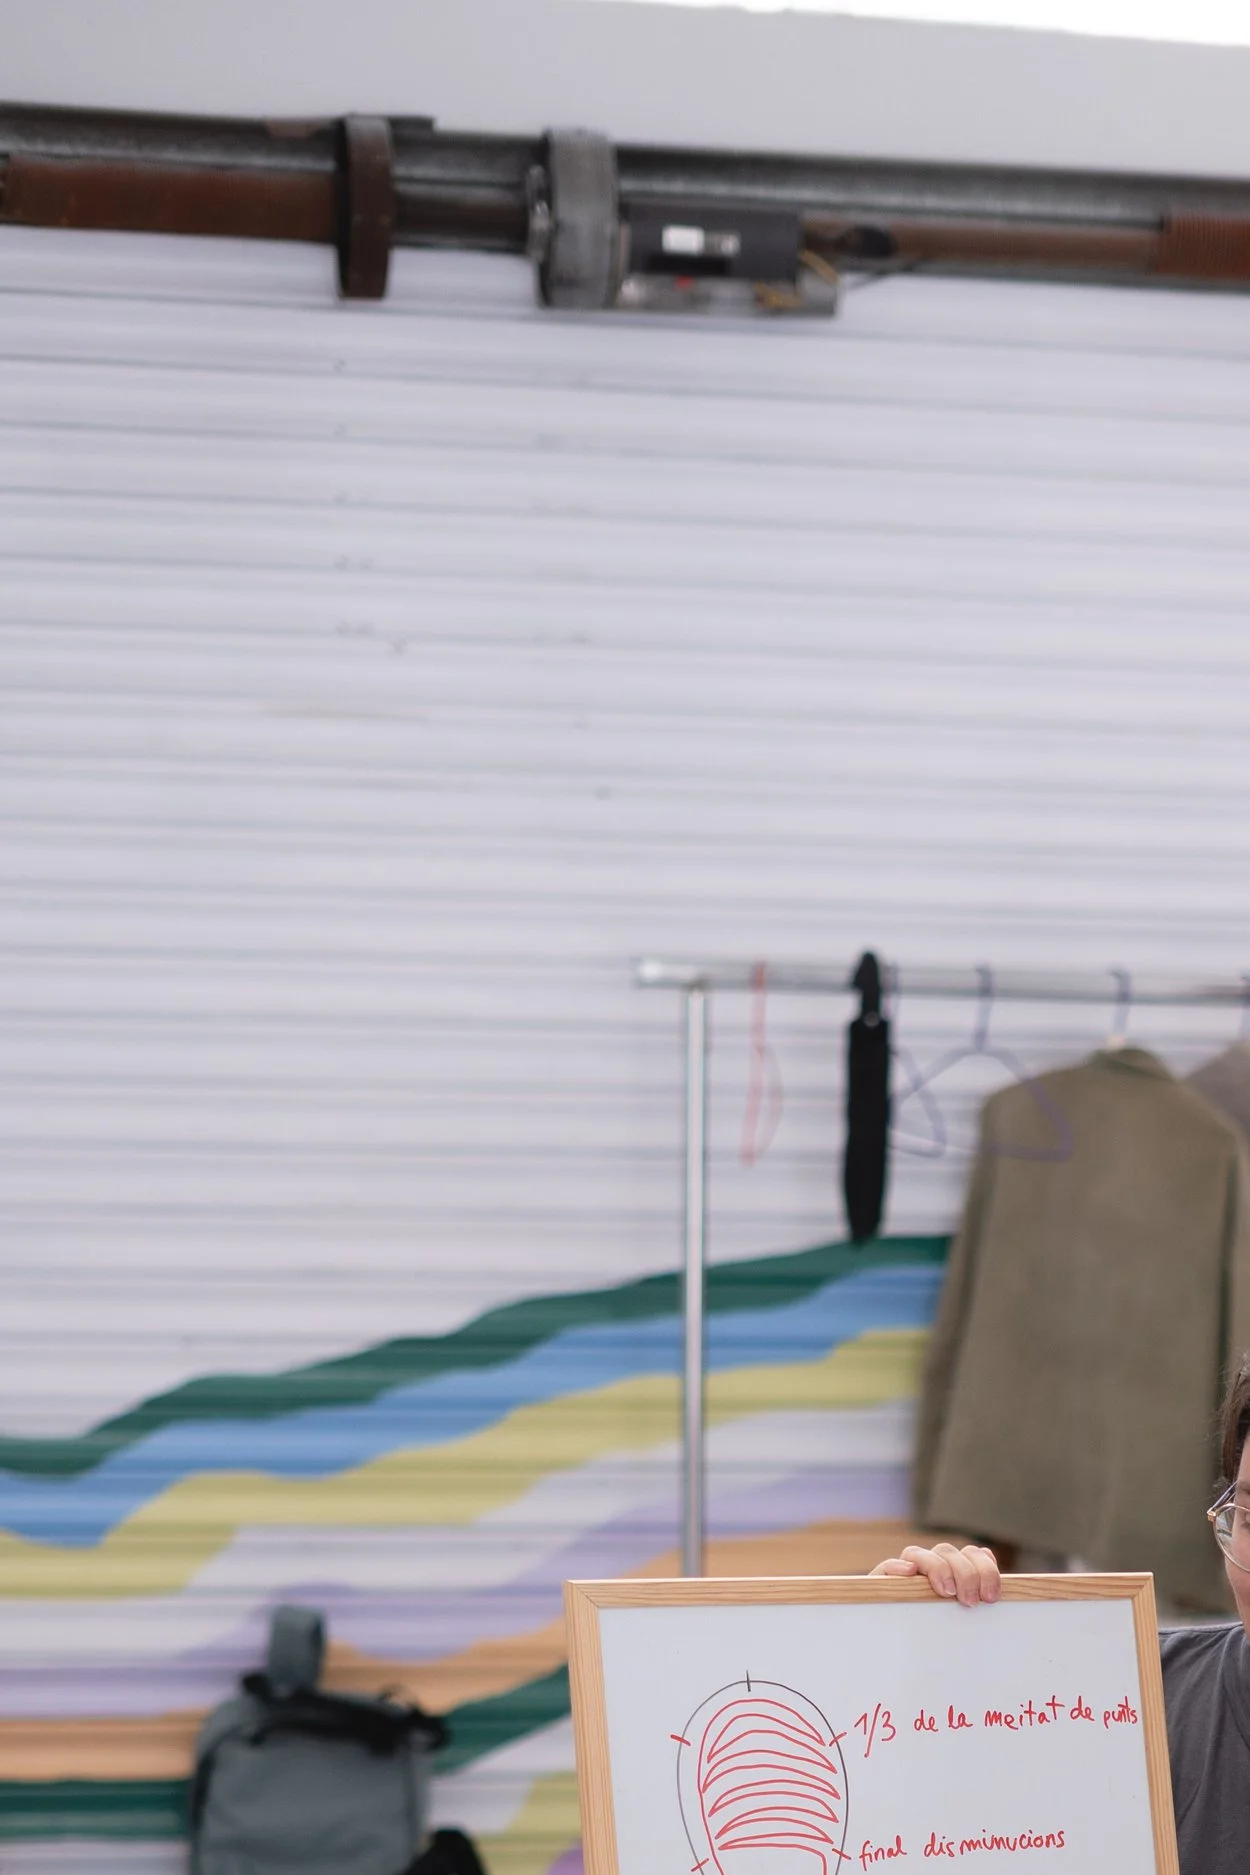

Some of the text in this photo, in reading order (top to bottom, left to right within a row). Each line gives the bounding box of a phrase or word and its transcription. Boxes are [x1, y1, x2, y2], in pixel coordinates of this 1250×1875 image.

[854, 1703, 896, 1758] 1/3
[914, 1709, 939, 1732] de
[948, 1705, 973, 1729] la
[984, 1695, 1065, 1730] meitat
[1069, 1695, 1095, 1722] de
[859, 1829, 1065, 1871] final disminucions
